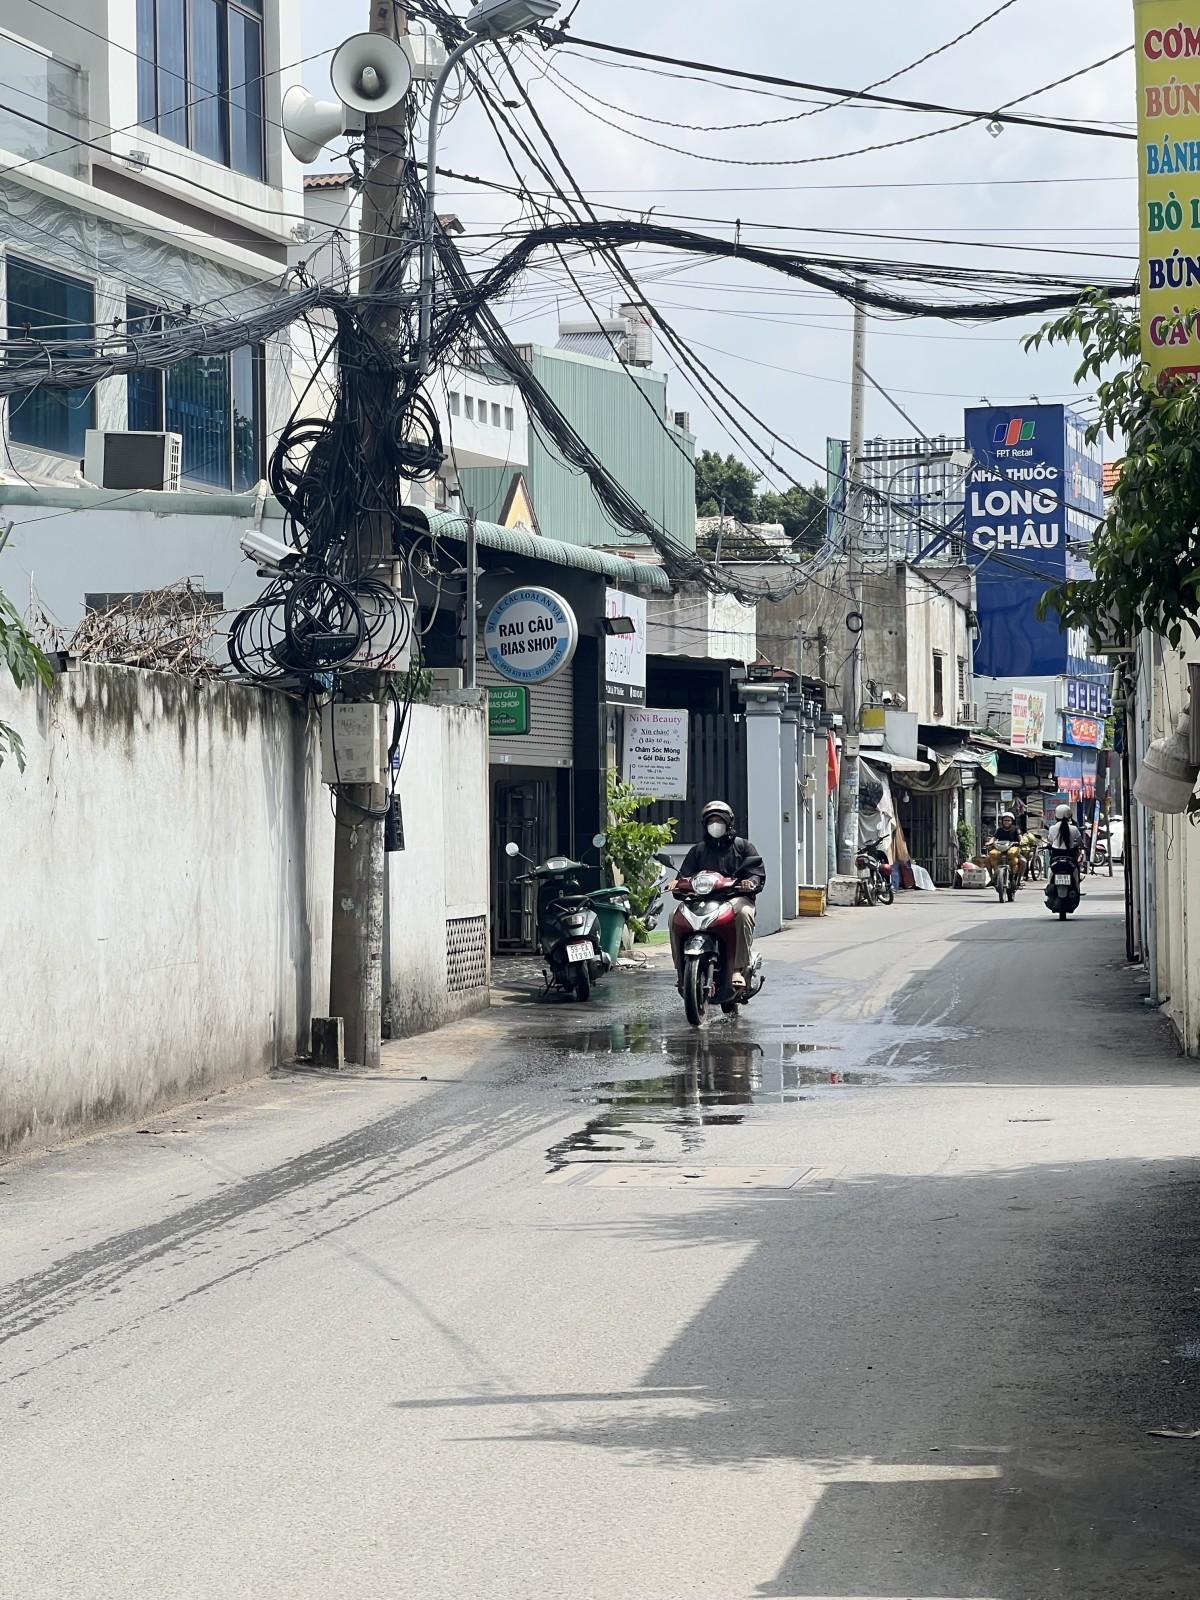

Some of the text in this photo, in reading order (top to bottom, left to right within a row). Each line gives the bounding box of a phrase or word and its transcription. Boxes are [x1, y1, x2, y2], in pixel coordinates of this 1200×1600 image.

[1144, 22, 1200, 60] CƠM
[1145, 77, 1200, 117] BÚN
[1146, 134, 1200, 174] BÁNH
[1148, 191, 1183, 231] BÒ
[1149, 249, 1200, 288] BÚN
[996, 447, 1033, 458] FPT Retail
[971, 461, 1058, 482] NHÀ THUỐC
[971, 488, 1058, 517] LONG
[972, 518, 1059, 551] CHÂU
[499, 616, 554, 637] RAU CÂU
[500, 636, 558, 656] BIAS SHOP
[629, 713, 682, 725] NiNi Beauty
